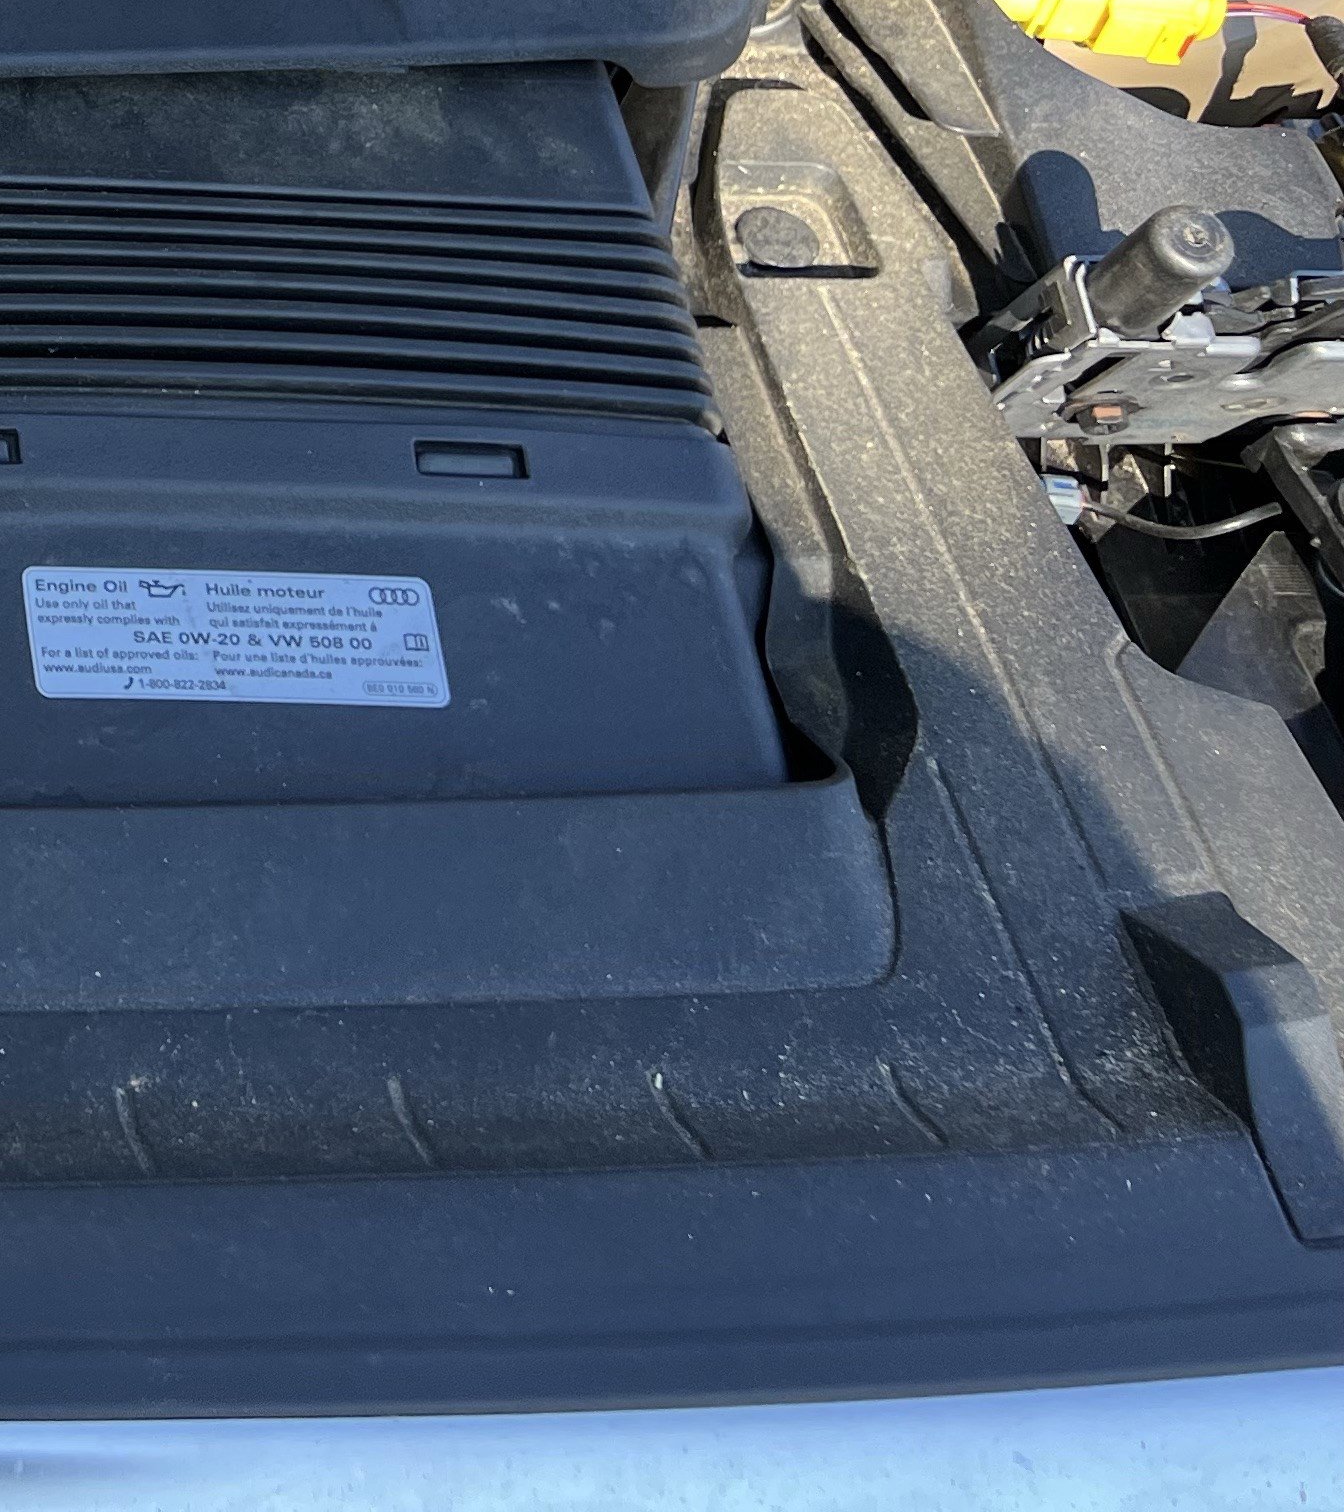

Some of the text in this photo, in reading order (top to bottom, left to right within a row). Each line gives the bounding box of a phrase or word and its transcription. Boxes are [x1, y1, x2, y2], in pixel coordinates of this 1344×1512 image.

[35, 579, 127, 595] Engine Oil
[205, 582, 325, 599] Huile moteur
[35, 598, 136, 611] Use only oil that
[206, 602, 250, 613] Utilisez
[253, 603, 325, 617] uniquement
[328, 605, 343, 617] de
[37, 614, 180, 626] expressly complies with
[209, 618, 228, 630] qui
[232, 618, 279, 630] satisfait
[133, 631, 373, 650] SAE 0W-20 & VW 508 00
[41, 647, 60, 658] For
[75, 647, 93, 659] list
[97, 647, 109, 659] of
[112, 648, 170, 661] approved
[173, 648, 198, 661] oils:
[213, 650, 242, 662] Pour
[245, 652, 267, 662] une
[270, 651, 297, 663] liste
[300, 651, 348, 664] d'huiles
[42, 663, 152, 674] www.audiusa.com
[214, 666, 332, 679] www.audicanada.ca
[139, 678, 226, 690] 1-800-822-2834
